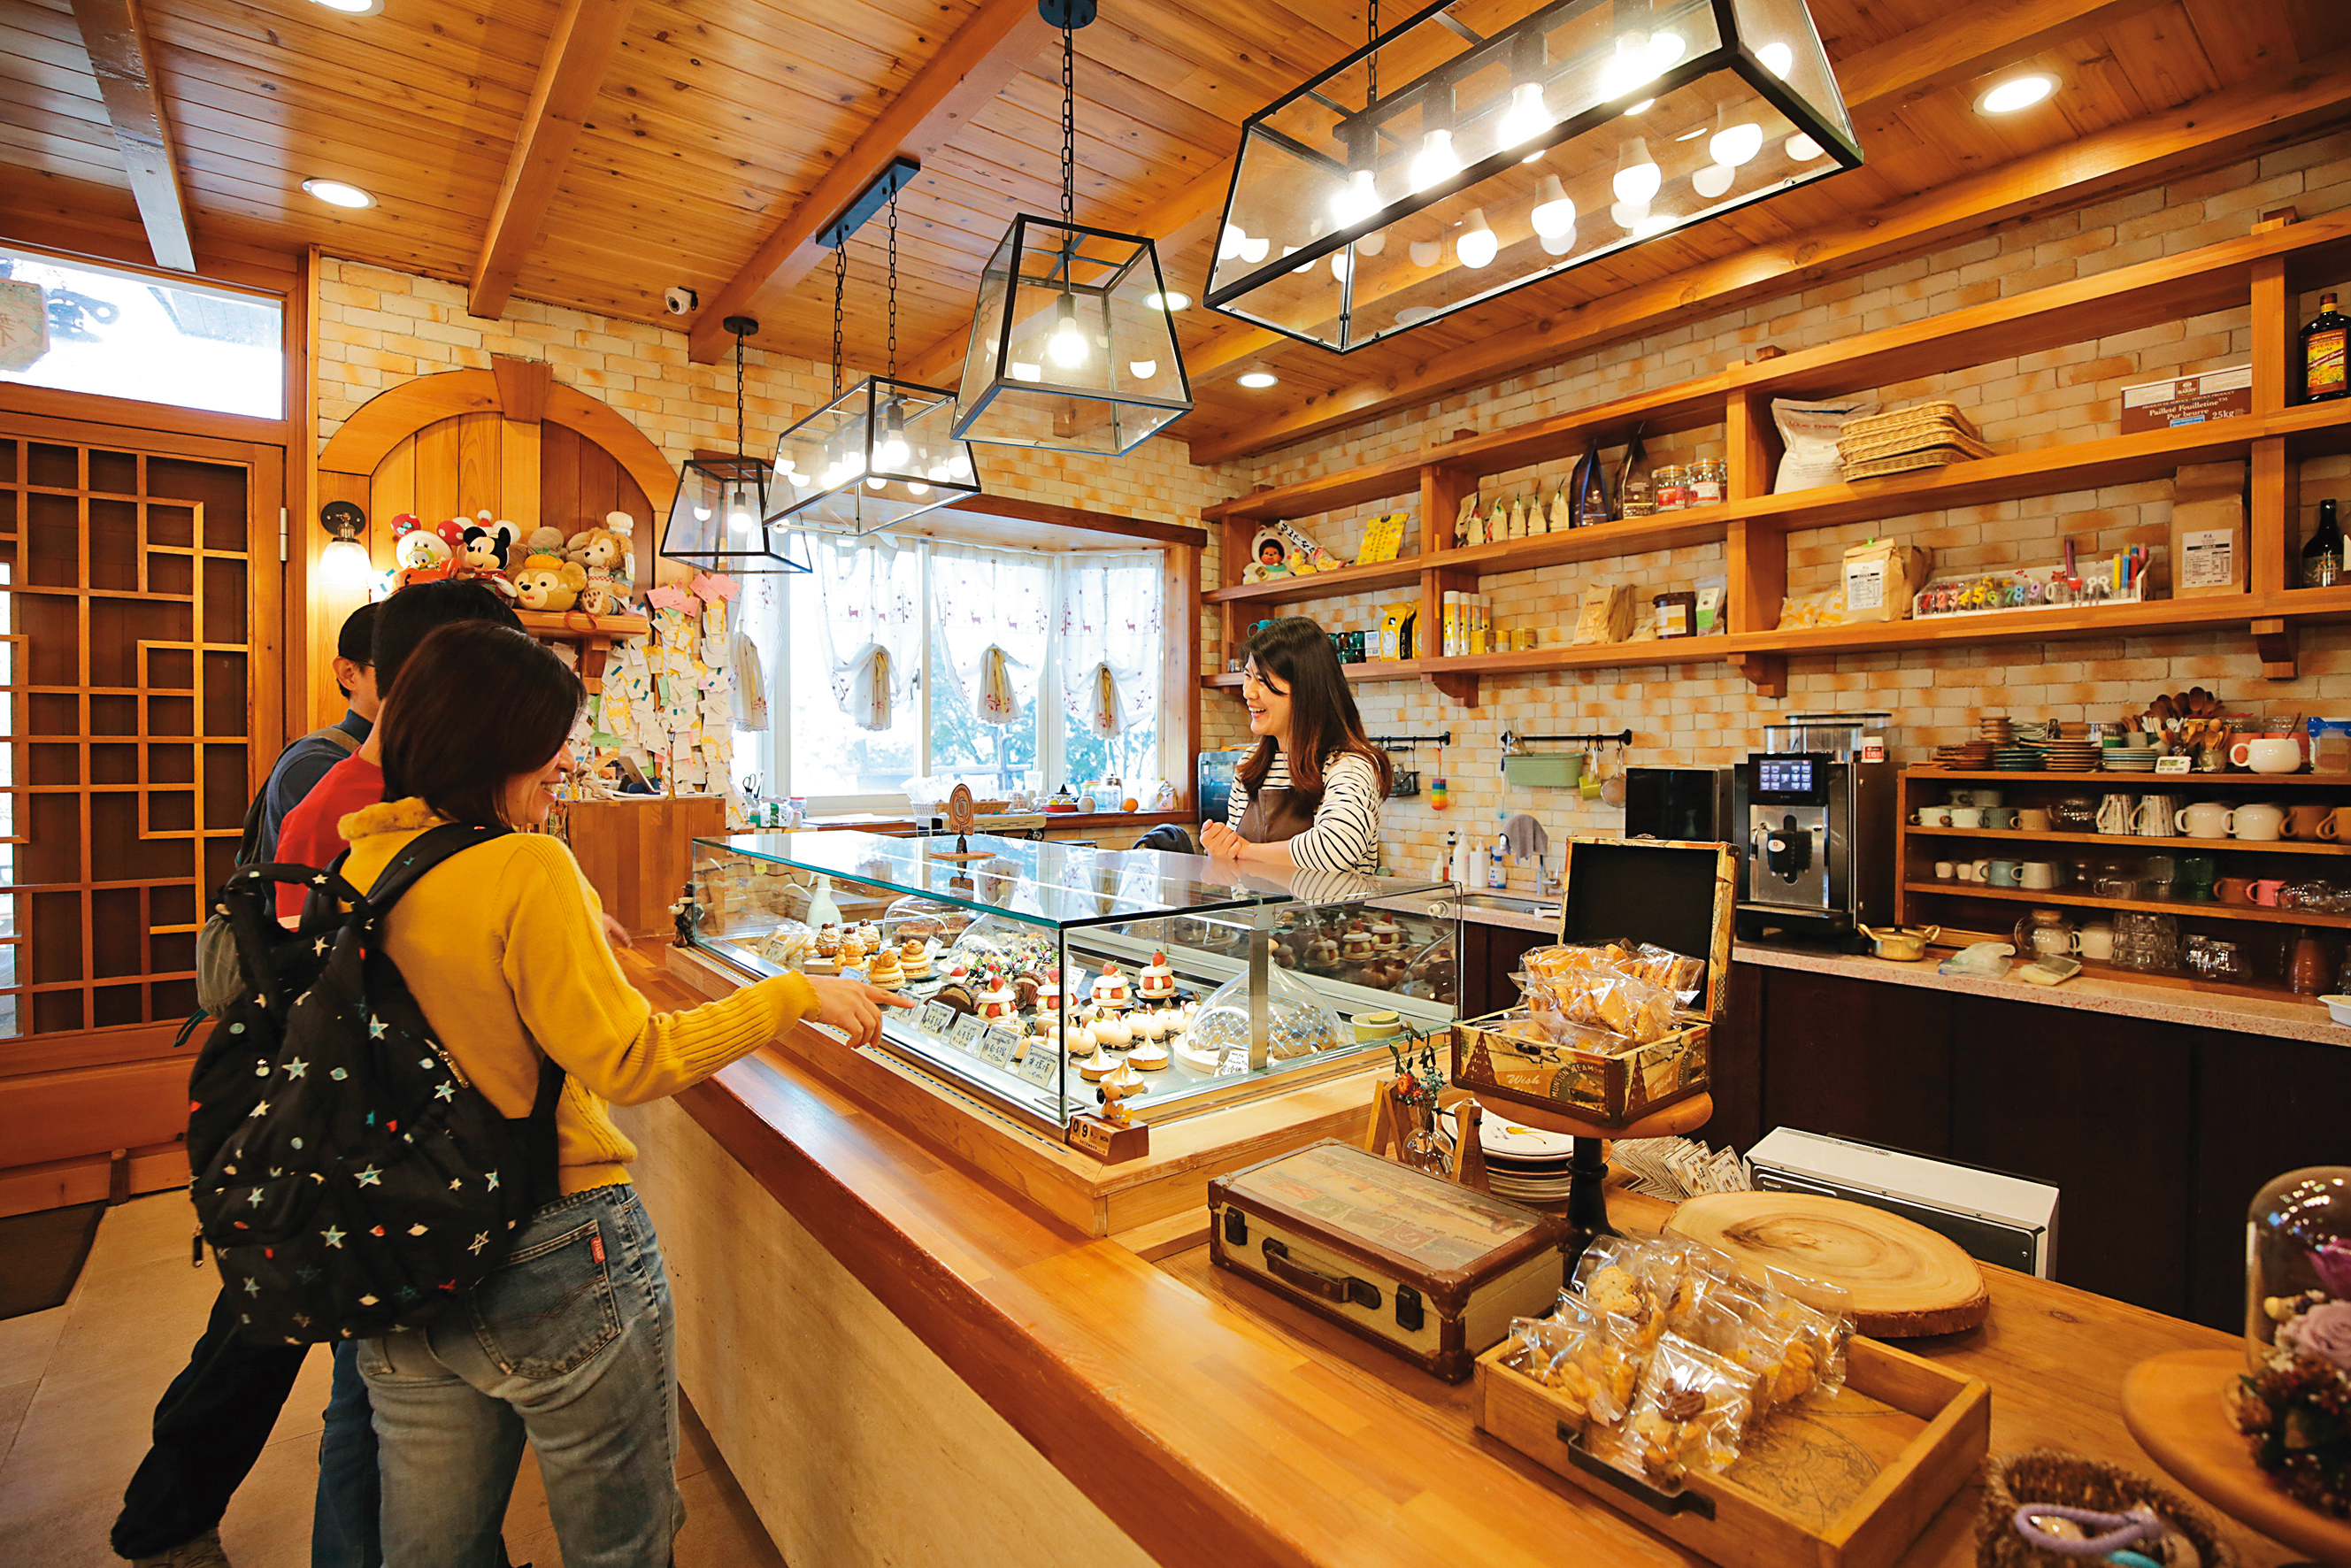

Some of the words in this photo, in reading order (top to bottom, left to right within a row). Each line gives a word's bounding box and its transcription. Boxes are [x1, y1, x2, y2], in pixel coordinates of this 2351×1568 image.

[2148, 405, 2177, 417] Pailleté
[2183, 408, 2209, 417] beurre
[1506, 1074, 1540, 1086] Wish
[1551, 1071, 1569, 1098] MUNSON
[1653, 1071, 1673, 1095] Wish
[1073, 1119, 1088, 1138] 09
